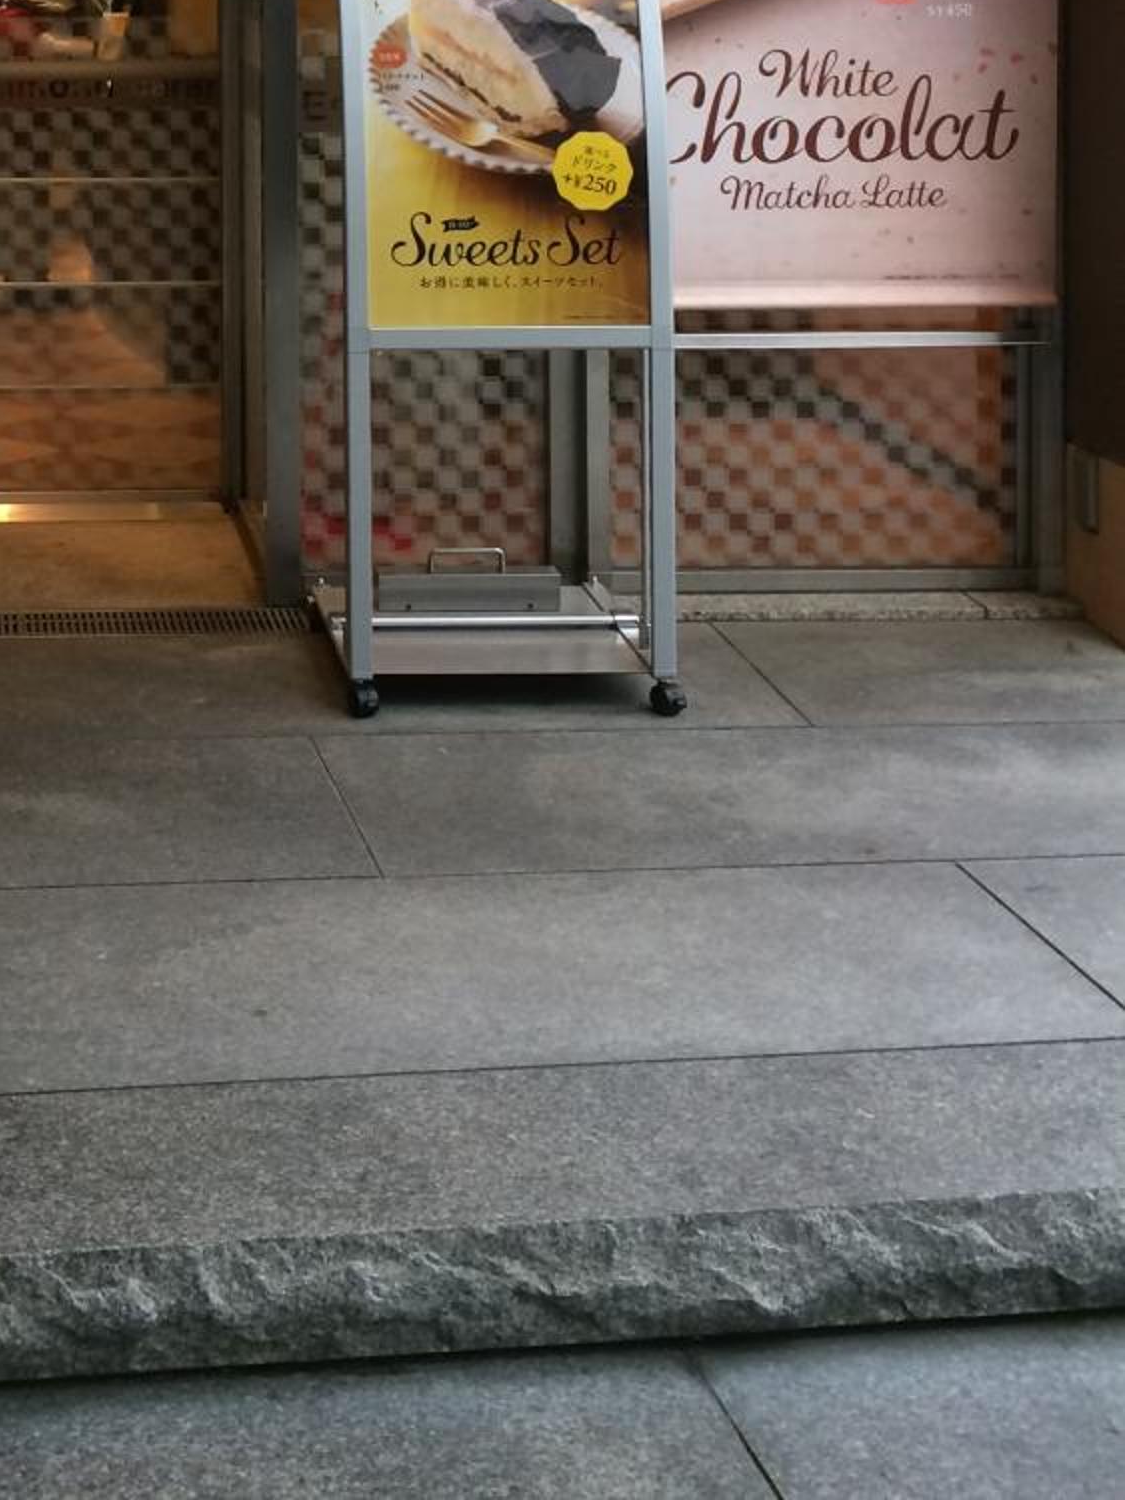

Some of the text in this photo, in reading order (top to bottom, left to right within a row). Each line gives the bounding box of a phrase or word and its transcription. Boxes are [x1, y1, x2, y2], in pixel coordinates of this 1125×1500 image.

[758, 47, 900, 99] White
[719, 173, 948, 211] Matcha Latte
[390, 211, 623, 268] Sweets Set
